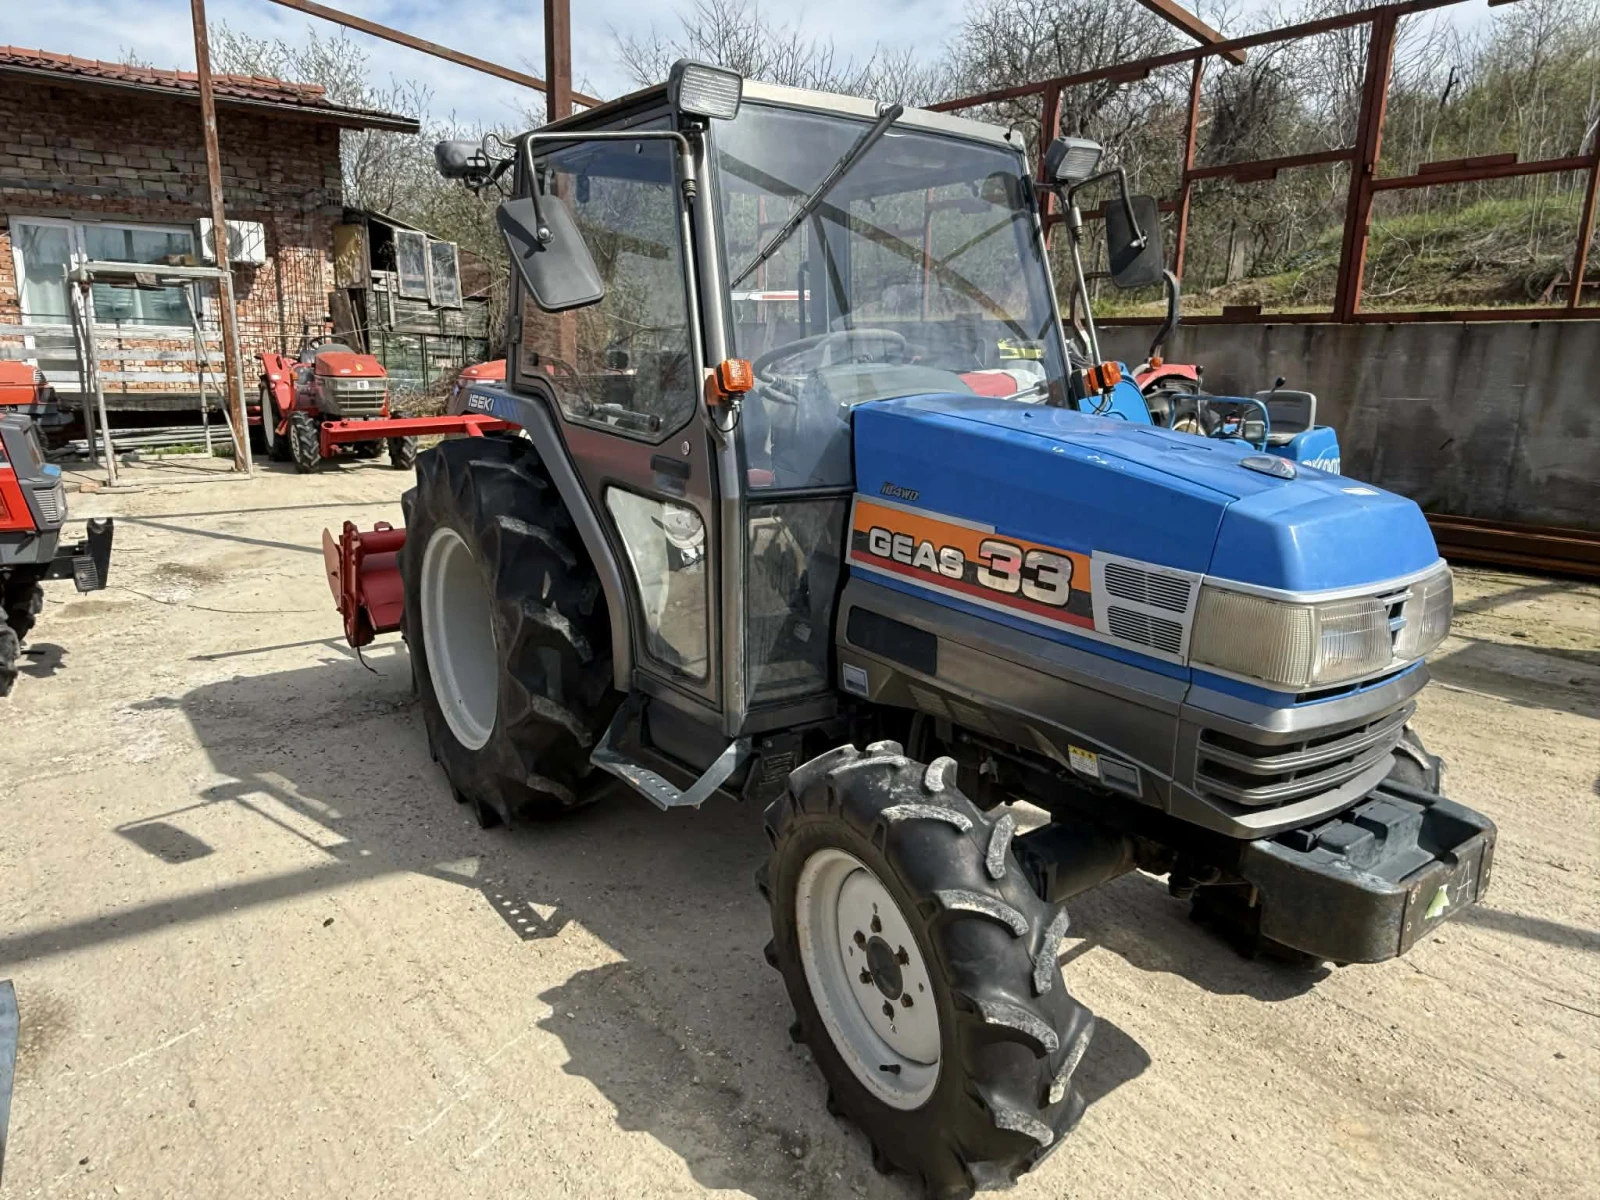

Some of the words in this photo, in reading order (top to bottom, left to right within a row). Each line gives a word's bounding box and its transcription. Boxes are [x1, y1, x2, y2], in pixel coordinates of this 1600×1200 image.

[468, 393, 495, 412] ISEKI
[869, 526, 965, 580] GEAS
[977, 538, 1073, 607] 33
